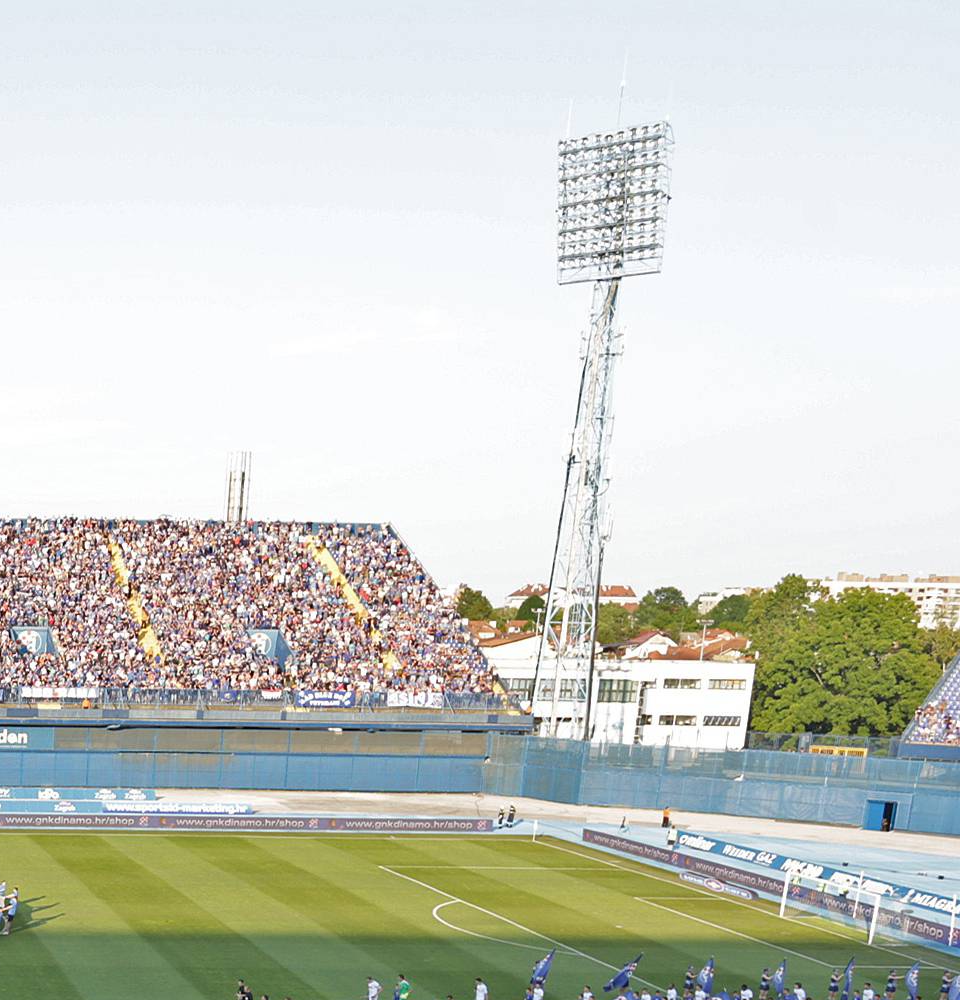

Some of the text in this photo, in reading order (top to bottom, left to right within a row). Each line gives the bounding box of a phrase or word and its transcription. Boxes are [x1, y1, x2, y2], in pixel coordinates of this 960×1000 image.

[5, 815, 135, 827] www.gnkdinamo.hr/shop
[176, 816, 305, 828] www.gnkdinamo.hr/shop
[345, 818, 473, 830] www.gnkdinamo.hr/shop
